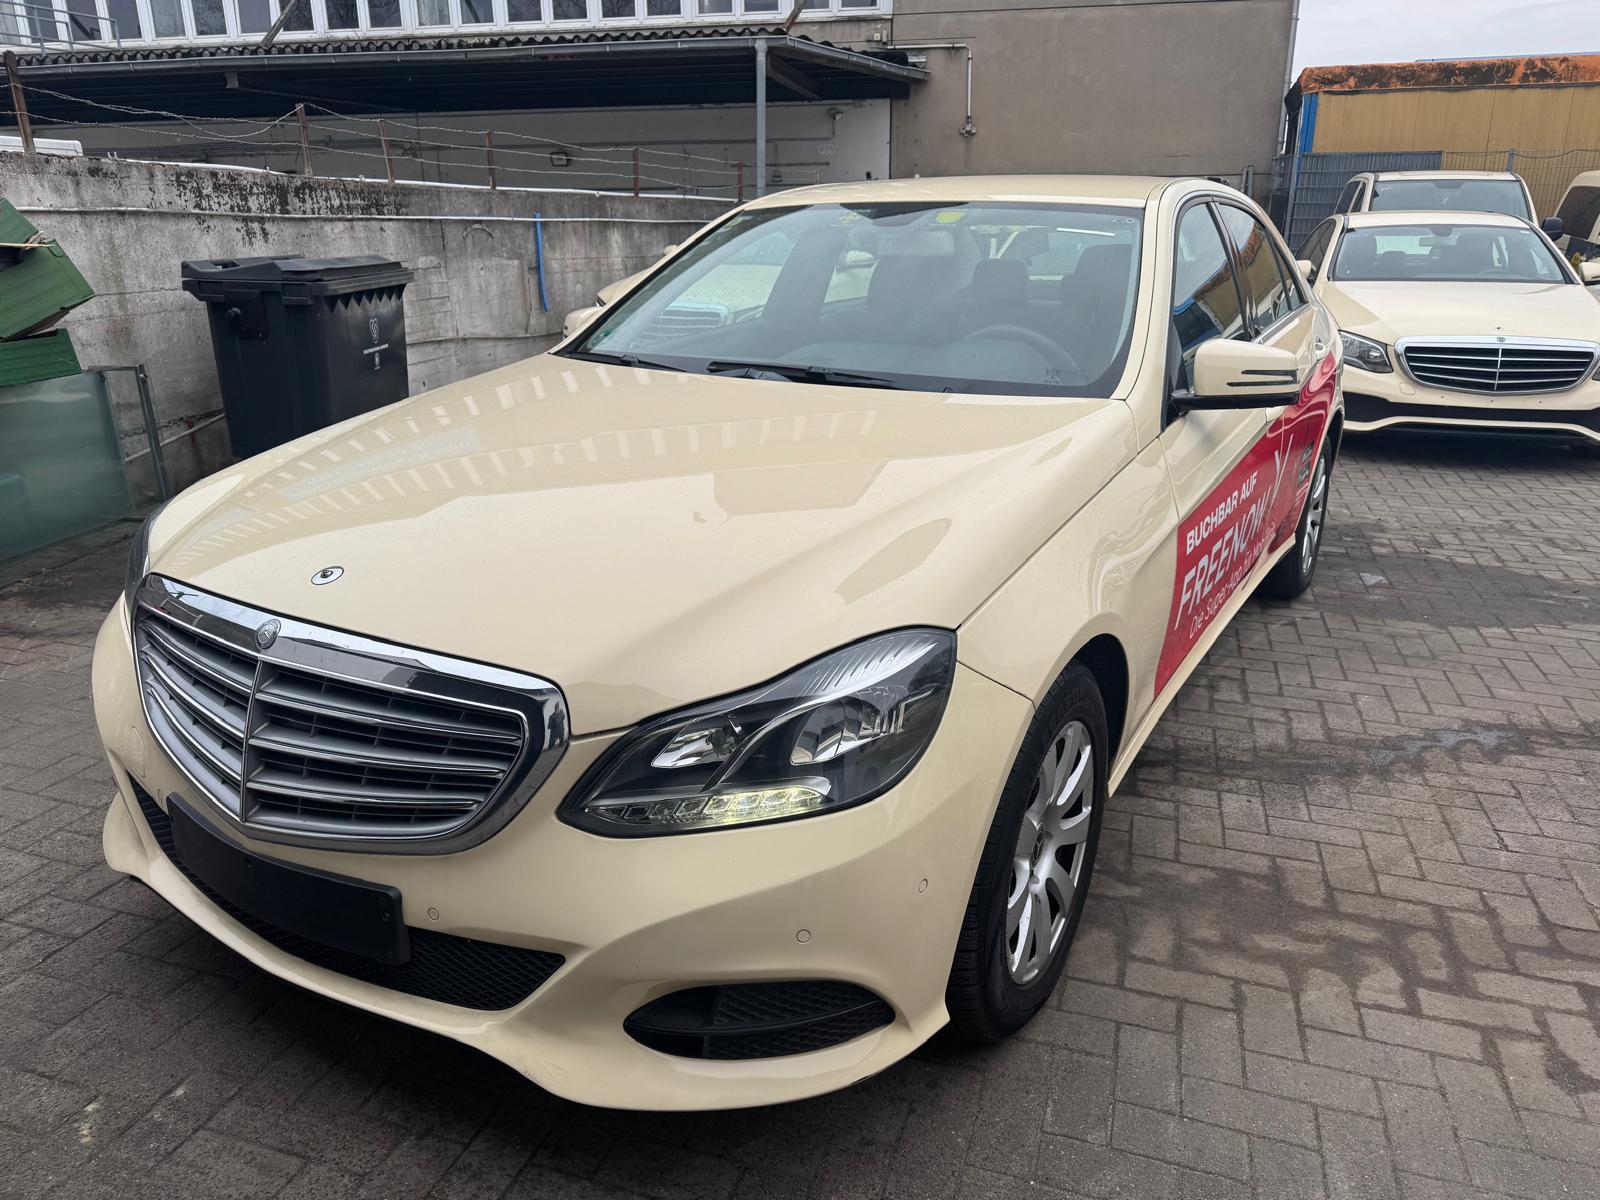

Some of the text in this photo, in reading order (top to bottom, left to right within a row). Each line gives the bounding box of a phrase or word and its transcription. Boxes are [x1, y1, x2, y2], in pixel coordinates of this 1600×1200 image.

[1186, 490, 1239, 555] BUCHBAR
[1239, 471, 1258, 506] AUF
[1174, 485, 1271, 631] FREENOW
[1189, 608, 1204, 639] Die
[1205, 566, 1242, 621] Super-App
